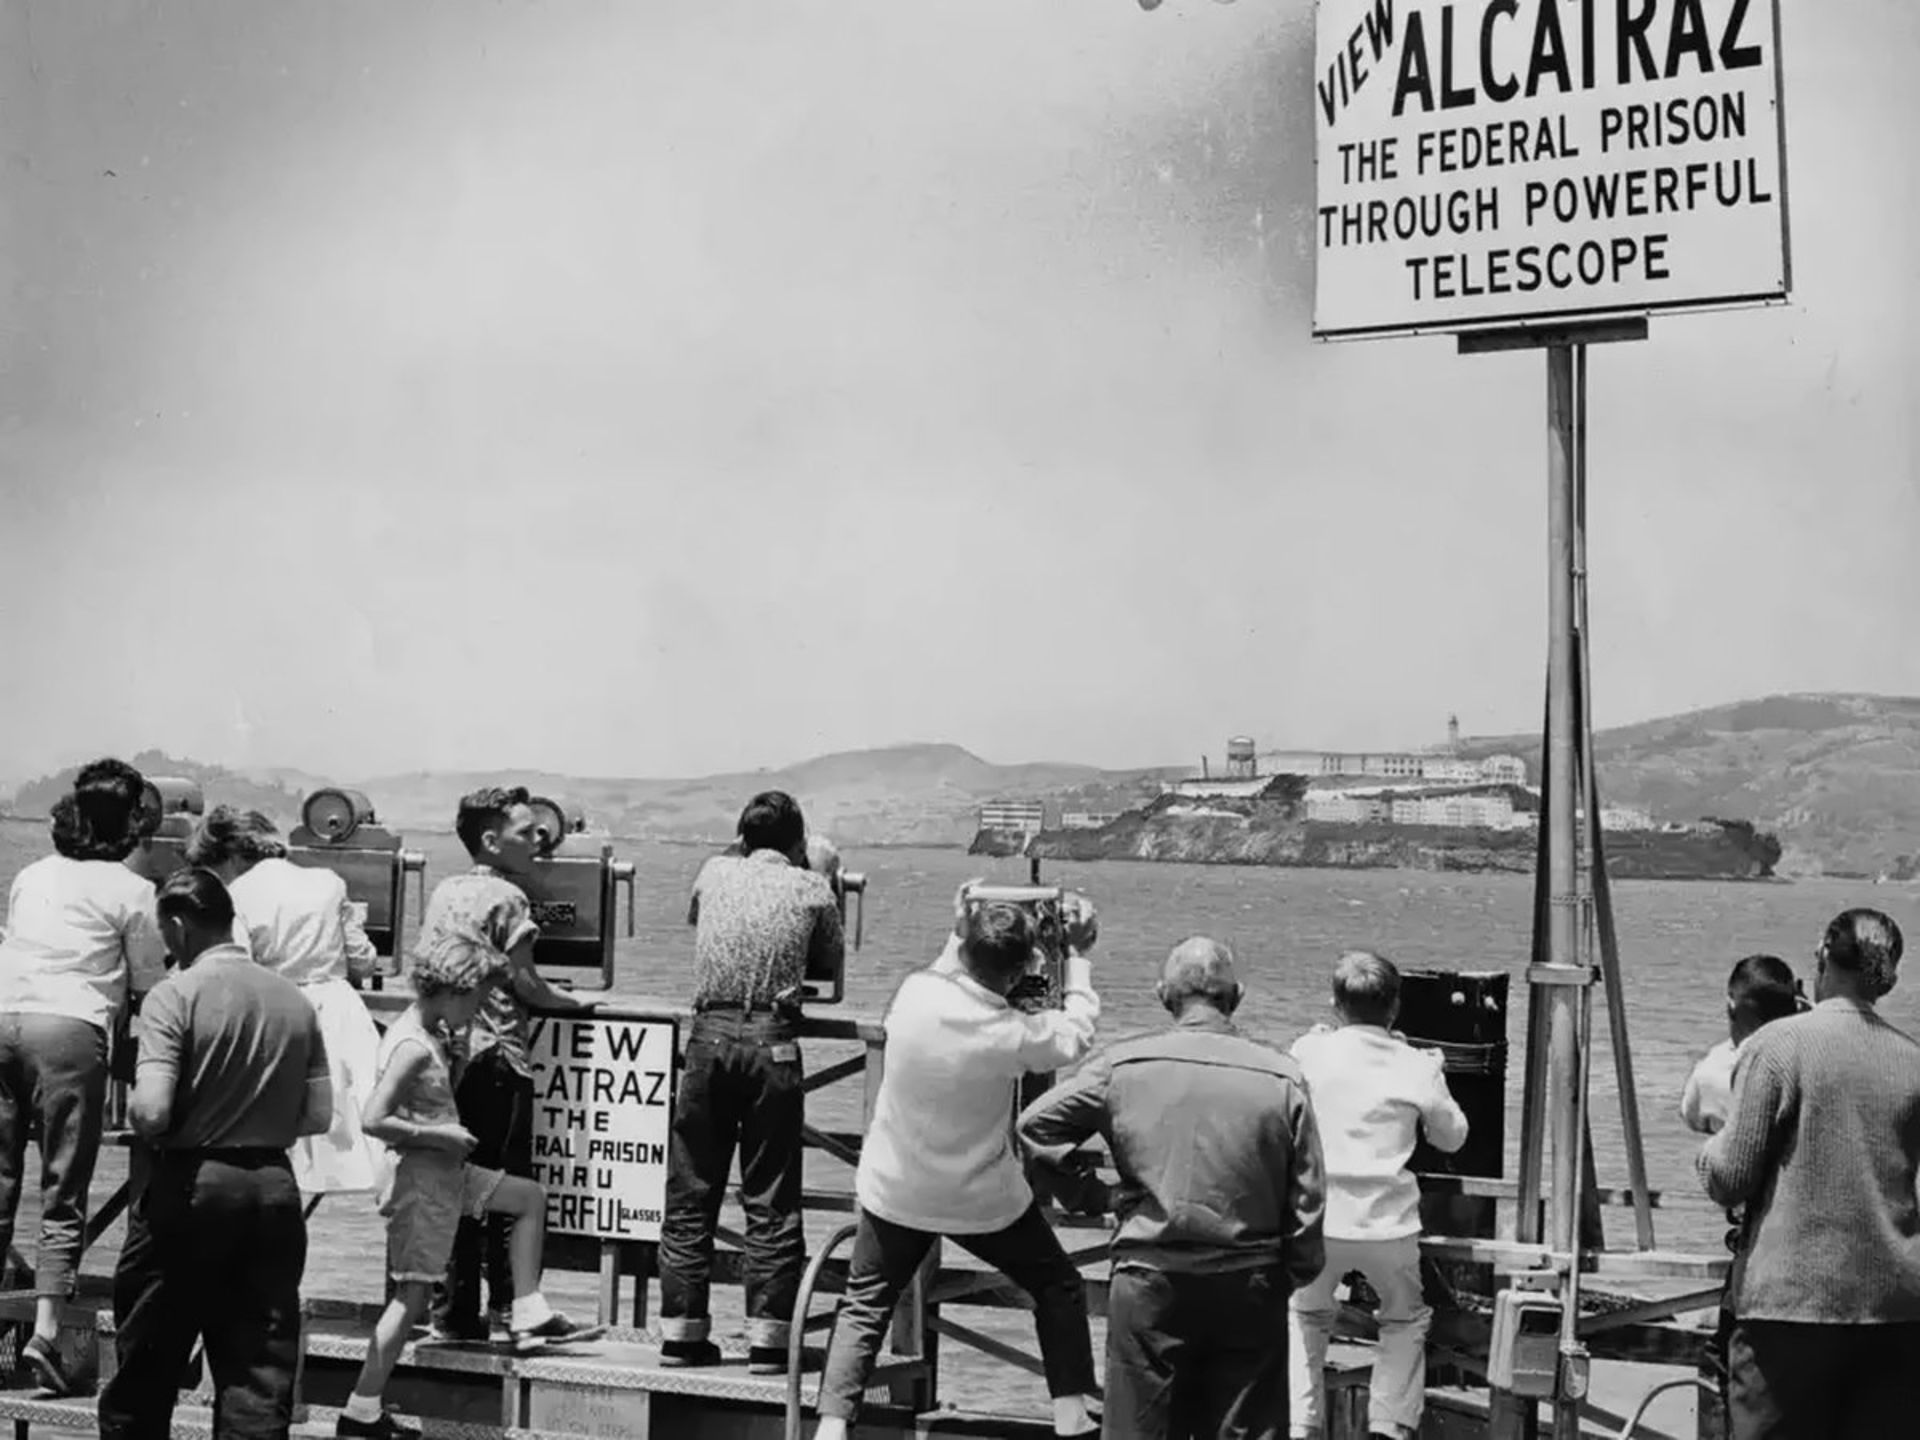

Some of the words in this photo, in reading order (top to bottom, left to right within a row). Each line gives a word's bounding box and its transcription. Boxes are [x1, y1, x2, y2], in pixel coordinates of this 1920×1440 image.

[1318, 0, 1393, 127] VIEW
[1391, 0, 1763, 117] ALCATRAZ
[1337, 137, 1398, 185] THE
[1417, 114, 1579, 176] FEDERAL
[1600, 91, 1746, 153] PRISON
[1318, 186, 1499, 248] THROUGH
[1525, 157, 1772, 227] POWERFUL
[1405, 233, 1670, 301] TELESCOPE
[542, 1106, 609, 1132] THE
[532, 1162, 612, 1189] THRU
[588, 1139, 664, 1165] PRISON
[621, 1207, 662, 1223] GLASSES
